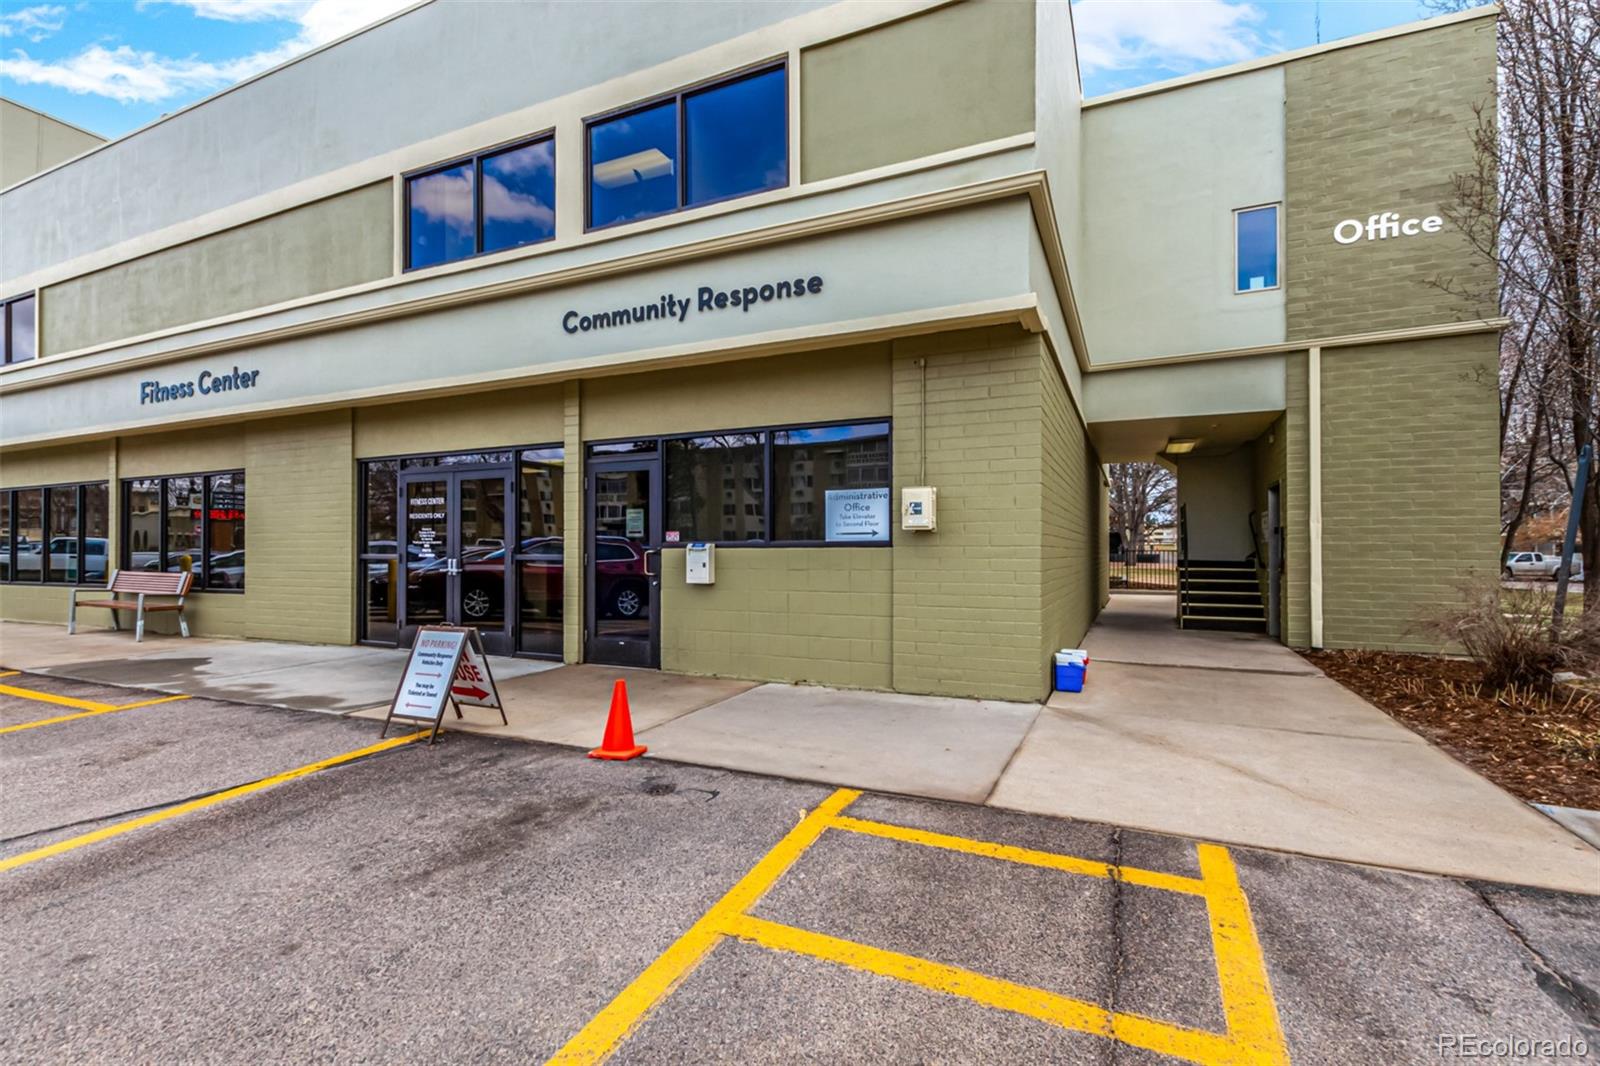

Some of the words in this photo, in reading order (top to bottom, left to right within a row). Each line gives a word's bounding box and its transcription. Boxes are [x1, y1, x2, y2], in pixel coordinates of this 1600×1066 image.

[1333, 212, 1443, 244] Office
[562, 294, 690, 334] Community
[698, 275, 824, 312] Response
[140, 380, 195, 405] Fitness
[198, 366, 260, 395] Center
[843, 502, 871, 512] Office
